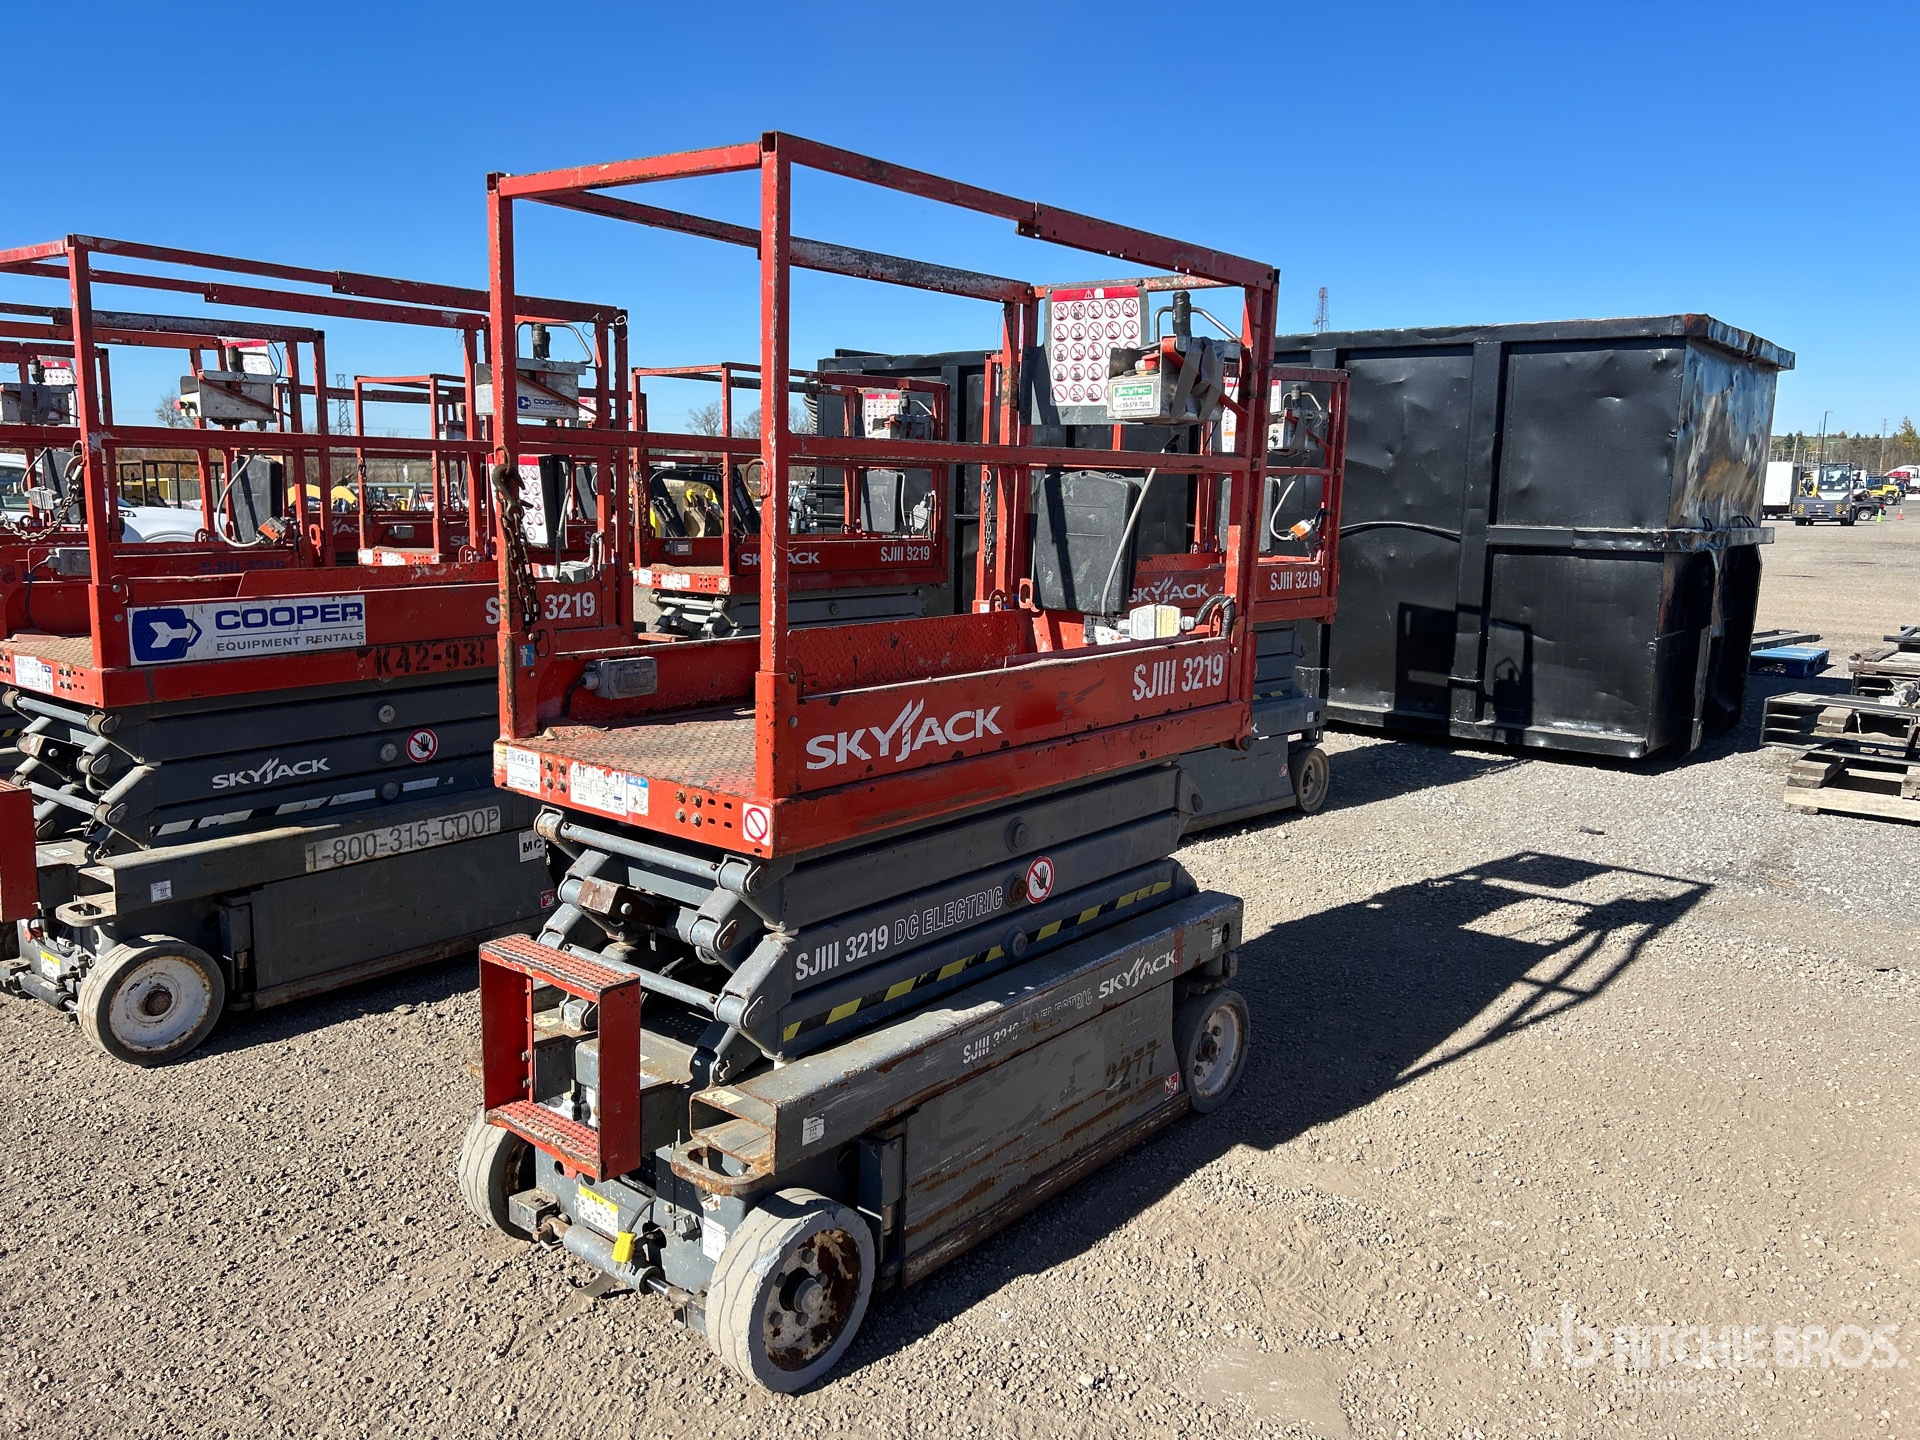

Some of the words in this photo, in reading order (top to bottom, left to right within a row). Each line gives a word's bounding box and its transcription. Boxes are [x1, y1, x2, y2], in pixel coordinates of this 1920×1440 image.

[741, 552, 820, 567] SKACK
[906, 545, 930, 561] 3219
[544, 591, 596, 620] 3219
[1128, 576, 1210, 605] SKYJACK
[215, 602, 363, 631] COOPER
[216, 636, 301, 652] EQUIPMENT
[306, 631, 364, 645] RENTALS
[1181, 653, 1225, 693] 3219
[806, 698, 1003, 771] SKYJACK
[211, 757, 331, 789] SKYJACK
[307, 808, 500, 870] 1-800-315-COOP
[845, 925, 889, 963] 3219
[894, 912, 919, 945] DC
[922, 885, 1003, 936] ELECTRIC
[1098, 950, 1178, 999] SKYJACK
